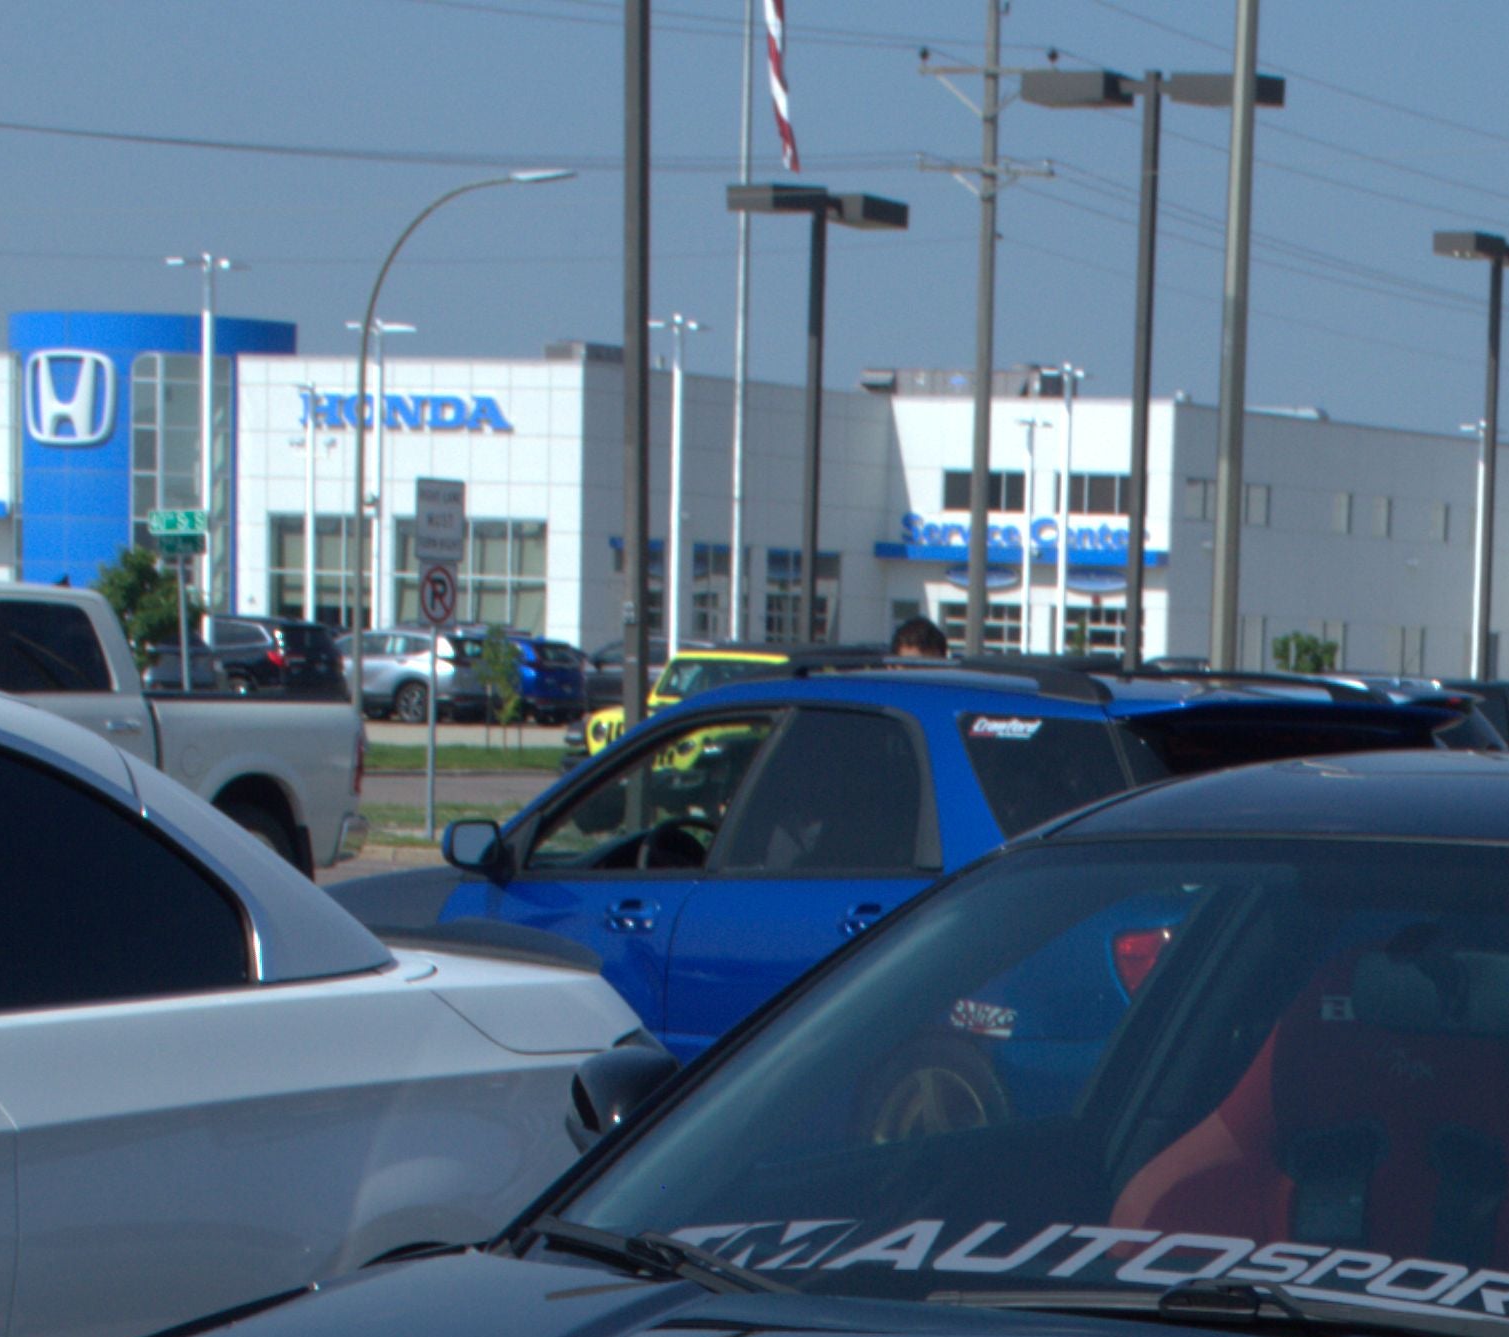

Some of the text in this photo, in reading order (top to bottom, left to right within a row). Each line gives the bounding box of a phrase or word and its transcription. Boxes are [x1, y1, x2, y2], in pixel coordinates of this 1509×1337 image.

[299, 393, 514, 434] HONDA
[902, 513, 1150, 549] Servce Cnte
